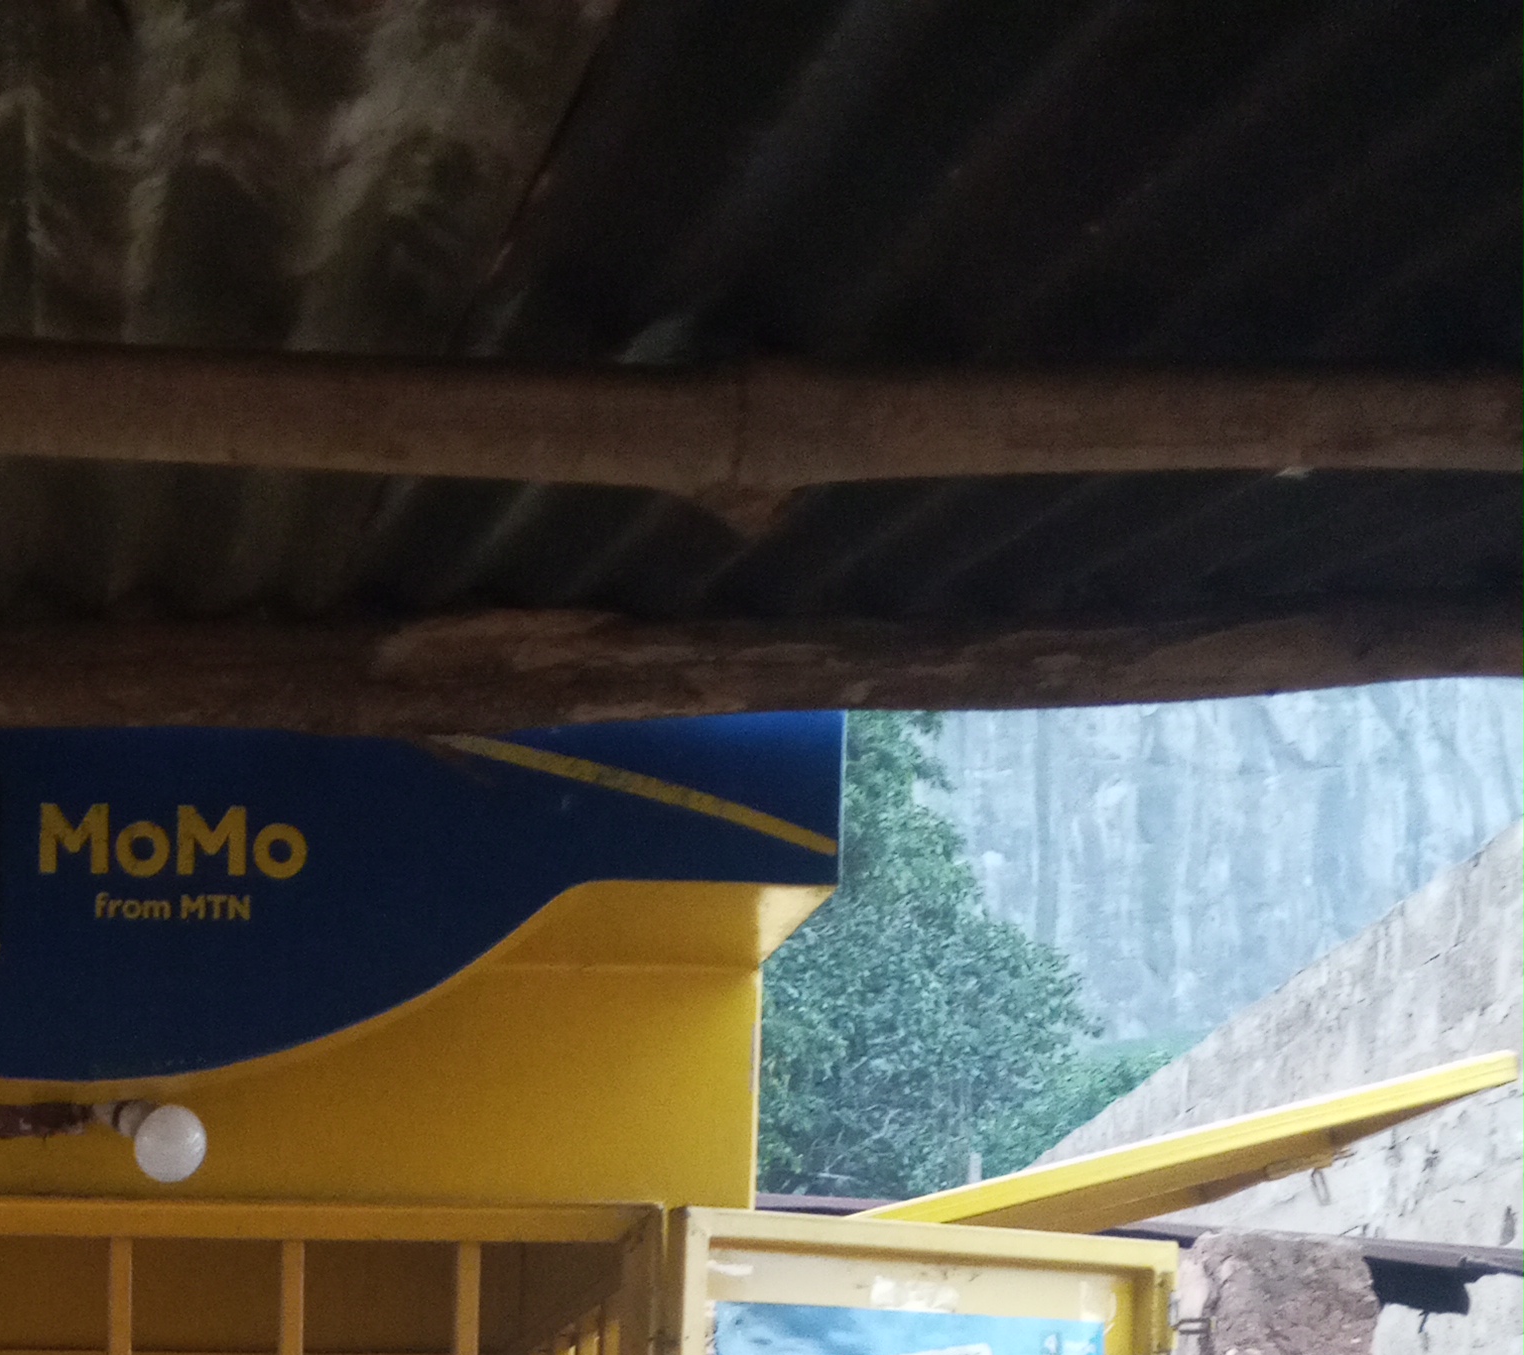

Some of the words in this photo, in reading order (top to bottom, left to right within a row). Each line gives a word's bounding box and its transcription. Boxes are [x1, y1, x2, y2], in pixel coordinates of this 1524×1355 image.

[38, 802, 307, 878] MoMo
[94, 891, 171, 919] from
[180, 894, 251, 920] MTN
